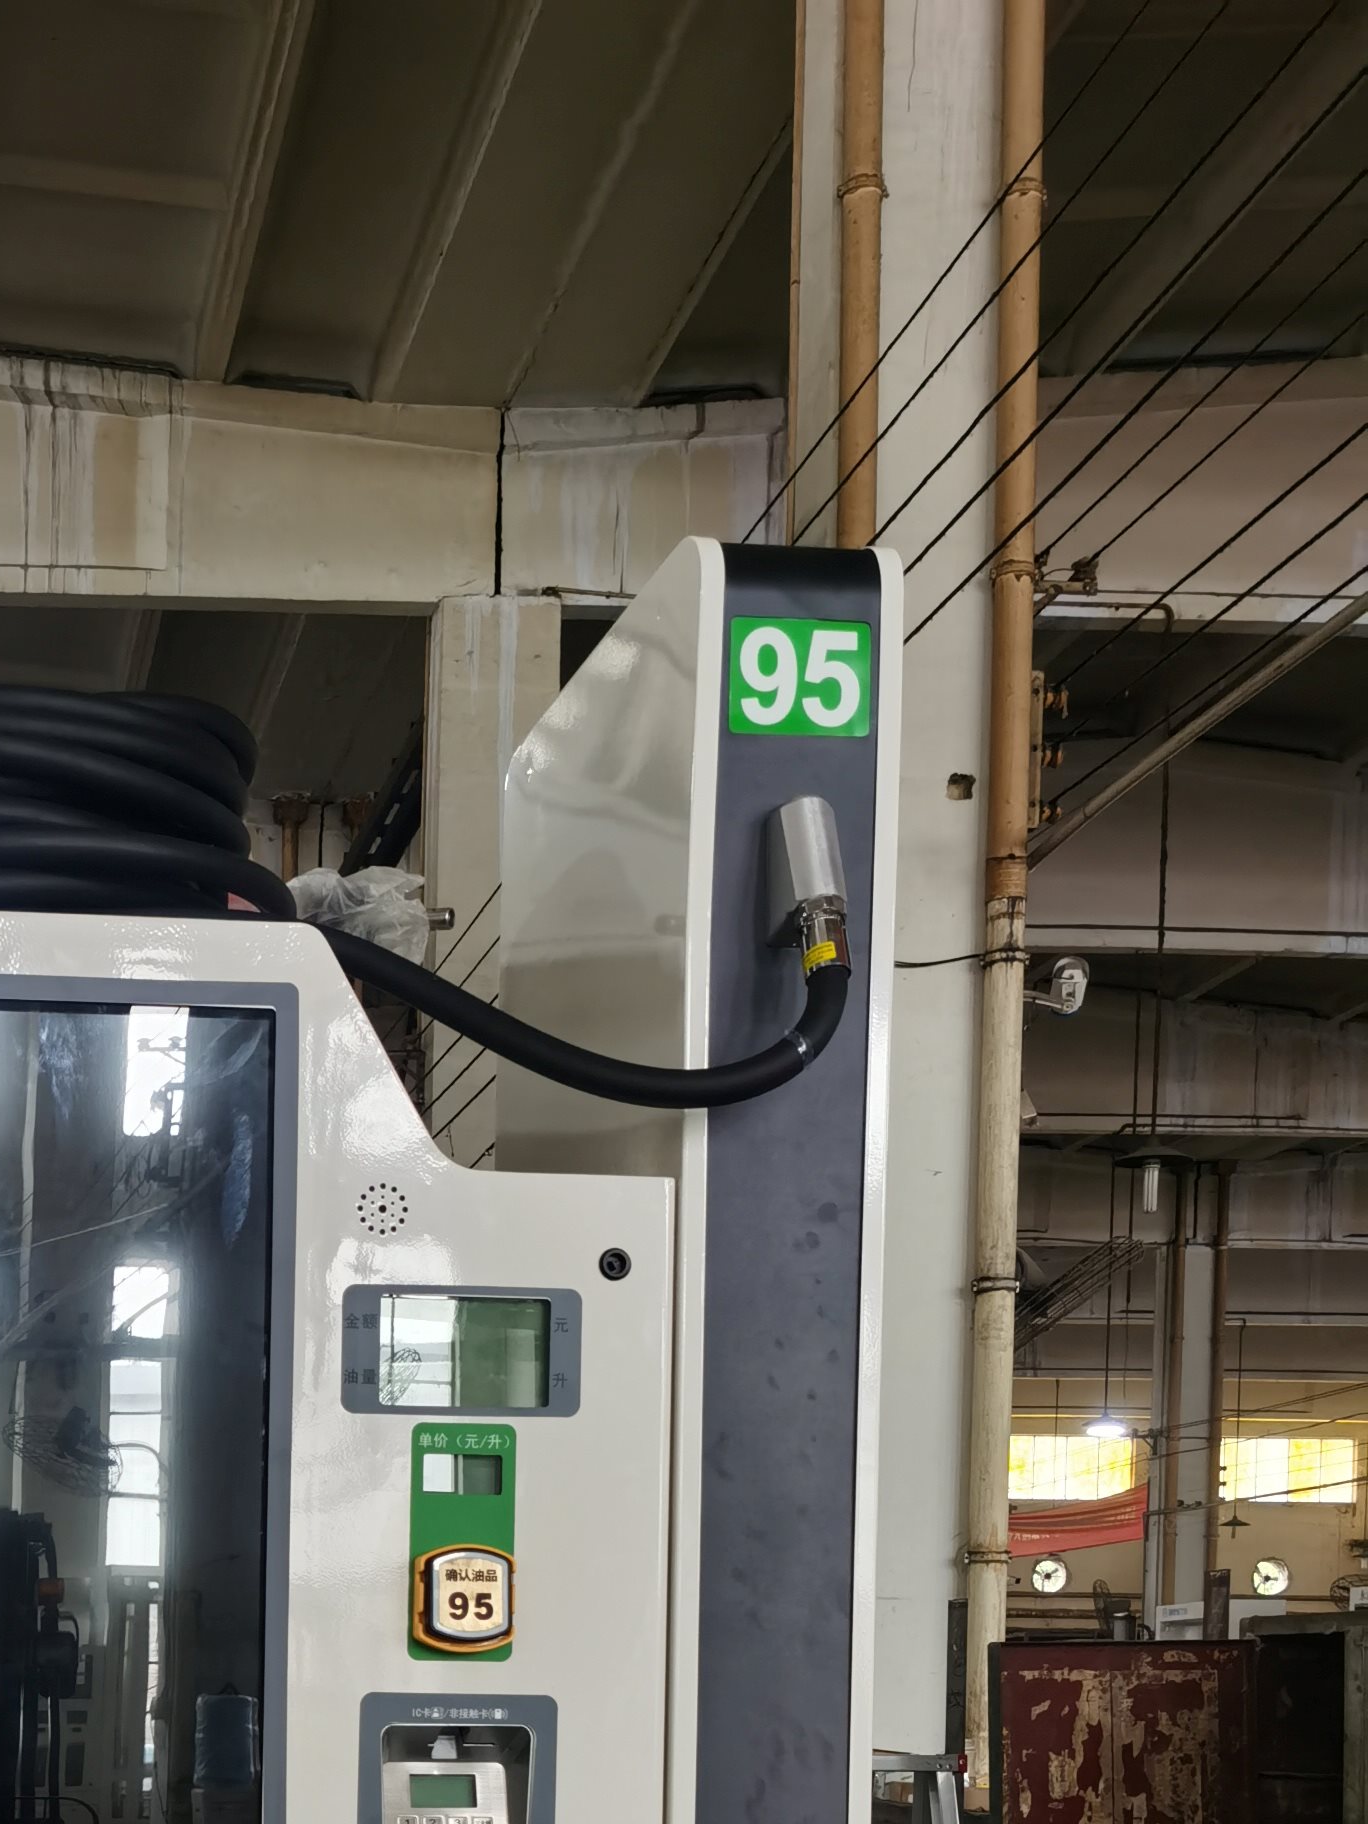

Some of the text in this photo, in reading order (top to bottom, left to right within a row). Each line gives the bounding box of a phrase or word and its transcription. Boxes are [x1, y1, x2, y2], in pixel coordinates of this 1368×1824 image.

[739, 626, 860, 728] 95
[344, 1313, 378, 1329] 金额
[554, 1317, 568, 1333] 元
[344, 1370, 377, 1385] 油量
[552, 1373, 567, 1388] 升
[445, 1568, 498, 1582] 确认油品
[449, 1592, 494, 1620] 95
